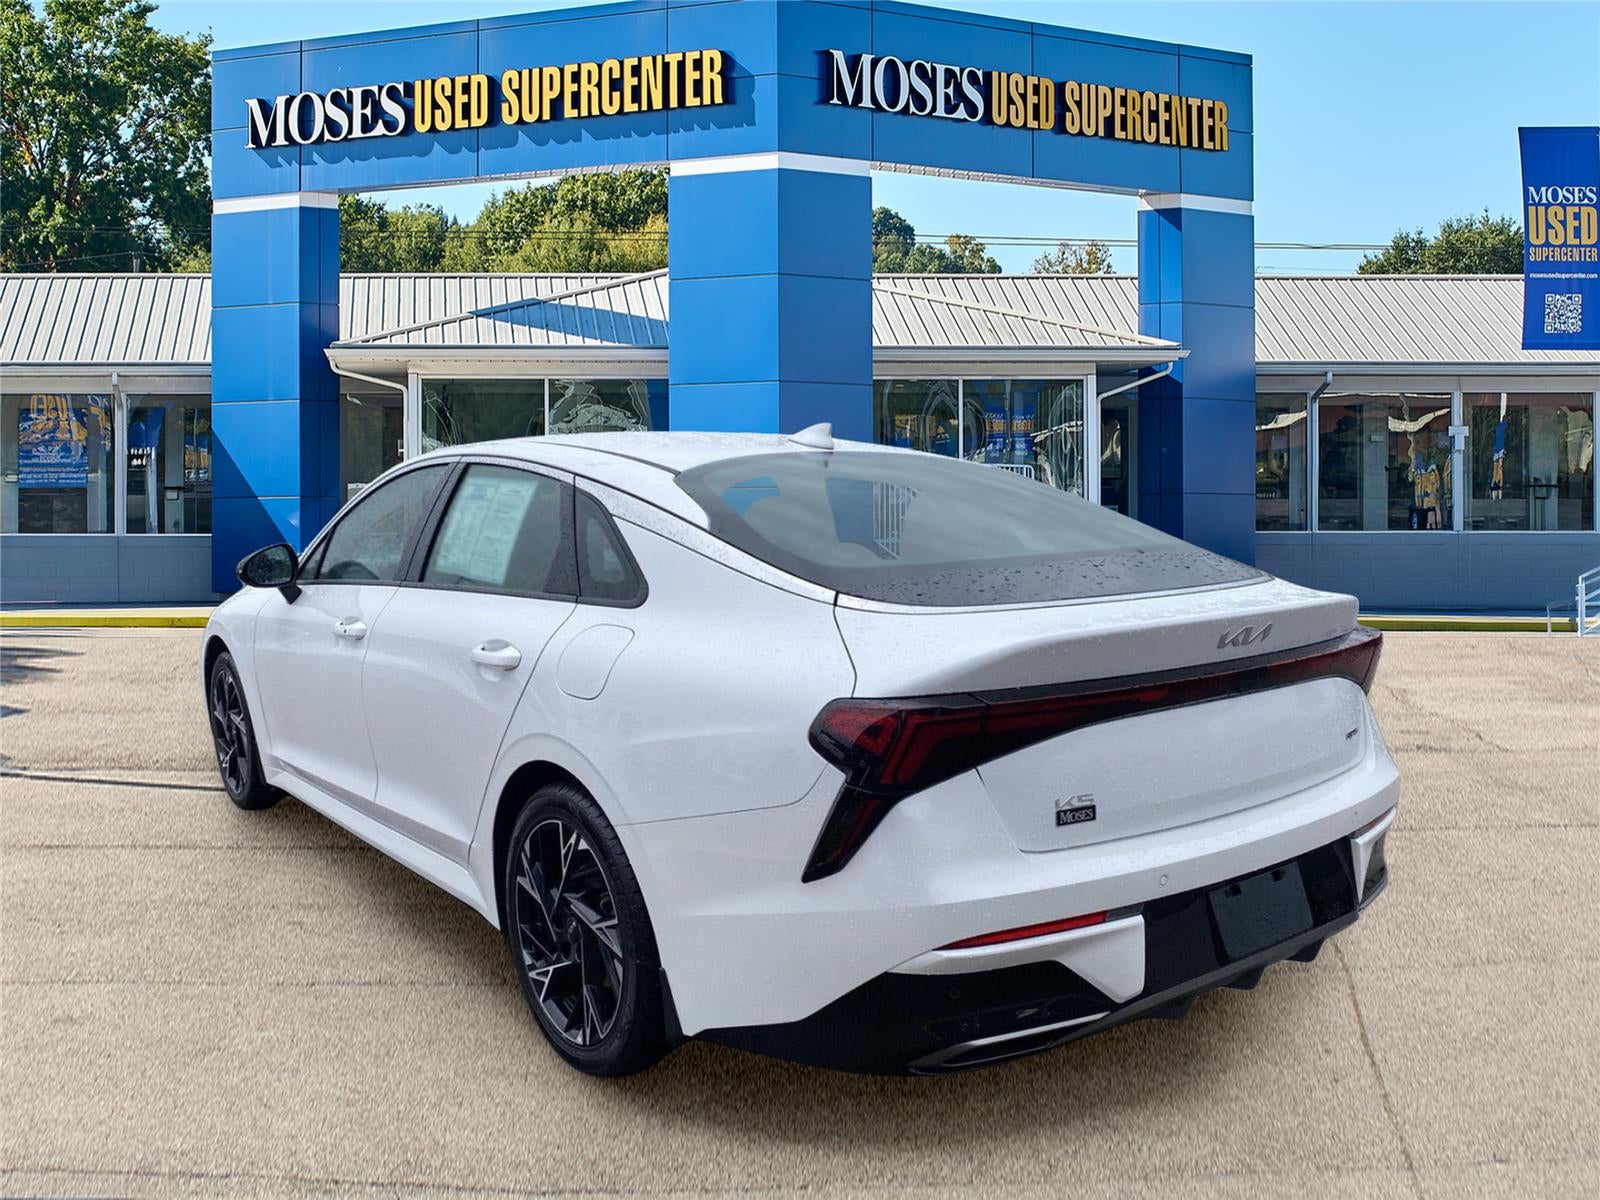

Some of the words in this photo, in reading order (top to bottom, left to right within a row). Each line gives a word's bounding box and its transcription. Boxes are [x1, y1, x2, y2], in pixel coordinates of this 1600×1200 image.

[245, 82, 406, 150] MOSES
[413, 73, 489, 133] USED
[501, 49, 724, 125] SUPERCENTER
[829, 48, 985, 122] MOSES
[991, 70, 1055, 131] USED
[1065, 80, 1230, 152] SUPERCENTER
[1527, 185, 1598, 205] MOSES
[1528, 205, 1599, 246] USED
[1529, 247, 1599, 262] SUPERCENTER
[1059, 809, 1094, 824] MOSES
